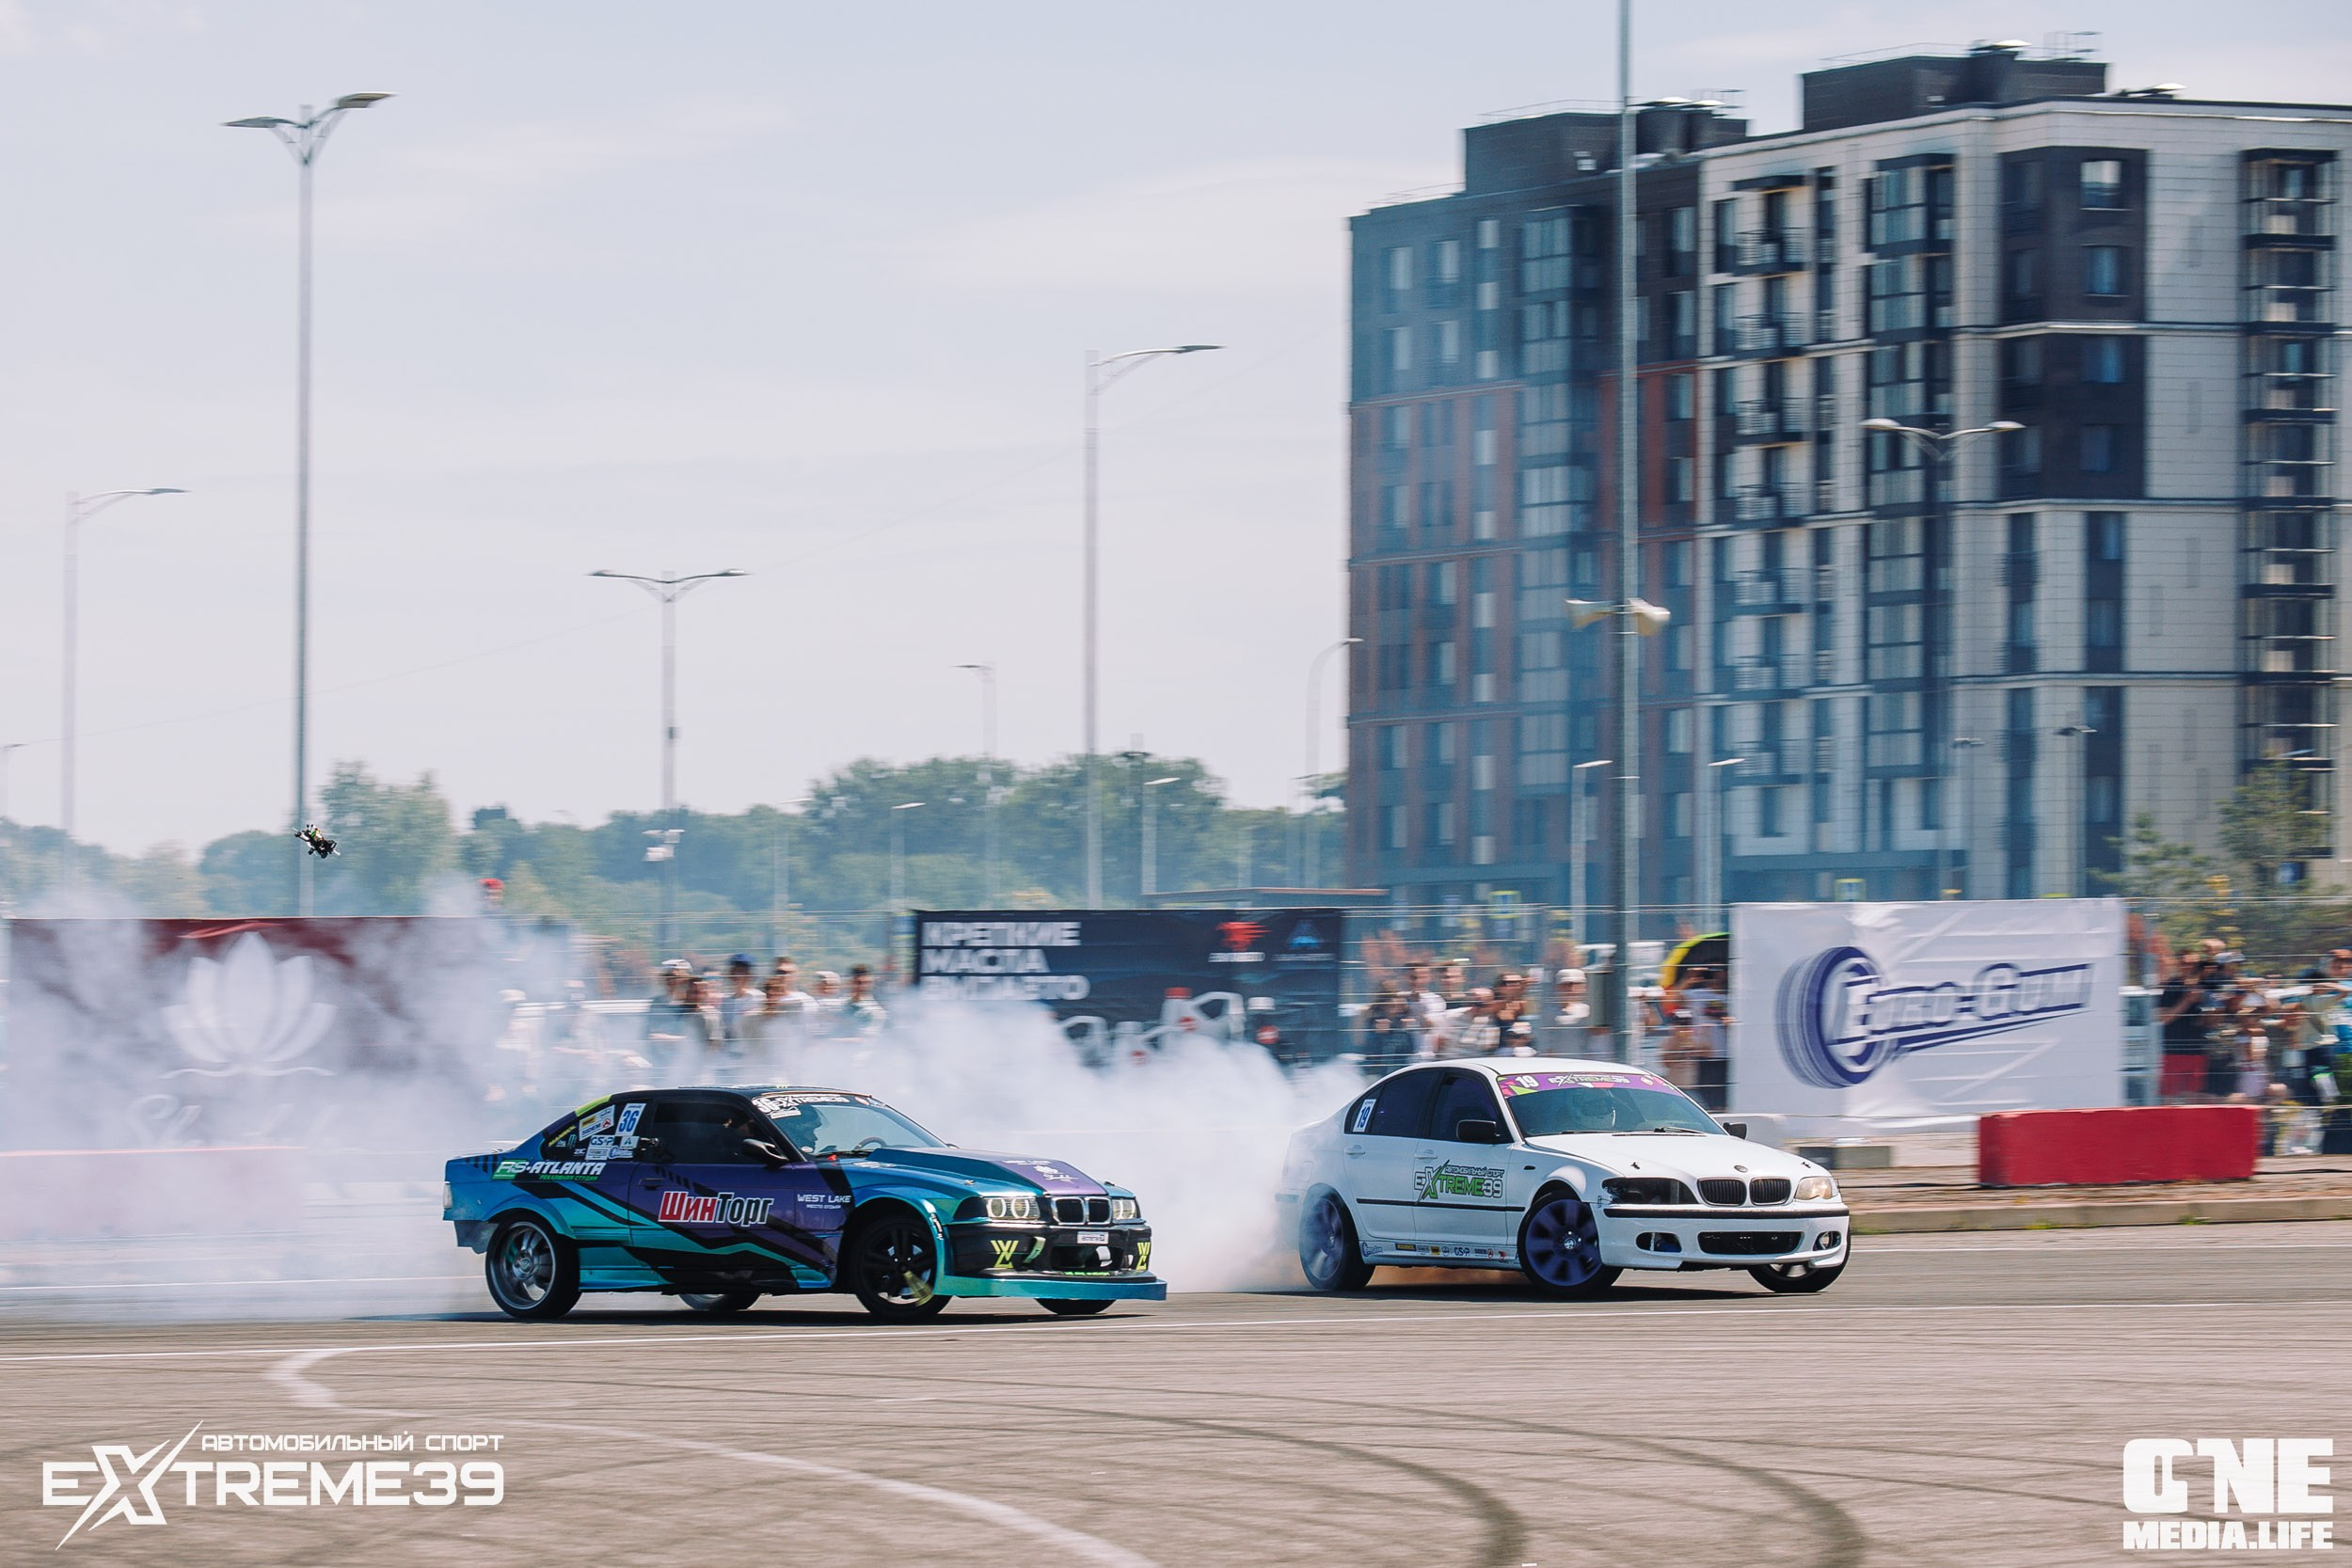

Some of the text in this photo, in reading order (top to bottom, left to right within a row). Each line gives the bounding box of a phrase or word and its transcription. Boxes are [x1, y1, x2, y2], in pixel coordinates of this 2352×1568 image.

[1516, 1075, 1540, 1088] 19
[618, 1110, 640, 1132] 36
[1357, 1106, 1371, 1129] 19
[1414, 1161, 1503, 1204] EXTREME39
[797, 1194, 852, 1203] WEST LAKE
